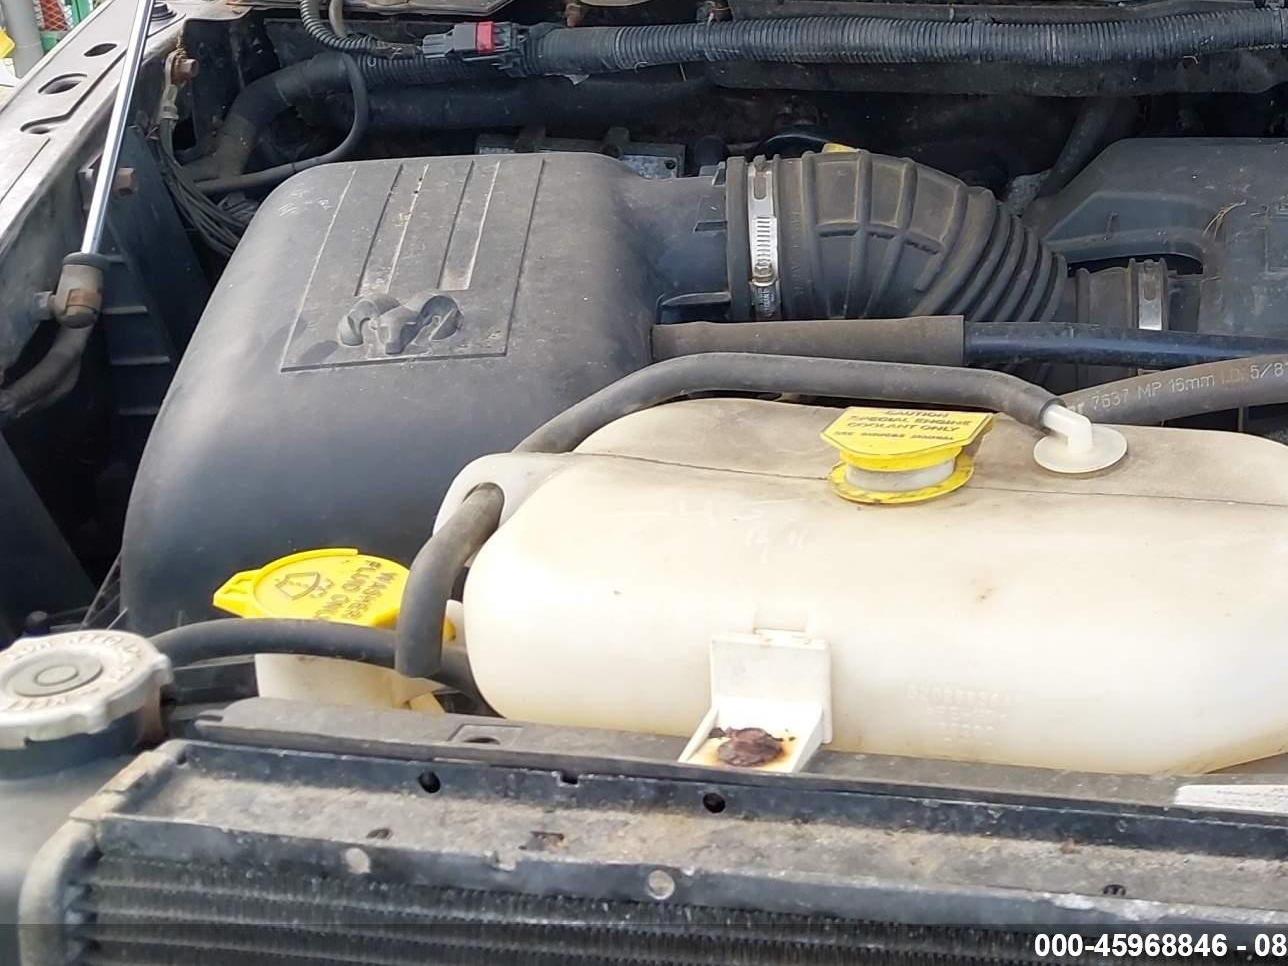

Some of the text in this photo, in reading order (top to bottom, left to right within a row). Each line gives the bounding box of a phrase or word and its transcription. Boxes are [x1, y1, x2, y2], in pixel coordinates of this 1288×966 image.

[1091, 388, 1128, 411] 7637
[1137, 381, 1162, 401] MP
[885, 410, 949, 418] CAUTION
[847, 422, 918, 430] COOLANT
[849, 415, 972, 426] SPECIAL ENGINE
[340, 571, 398, 619] WASHER
